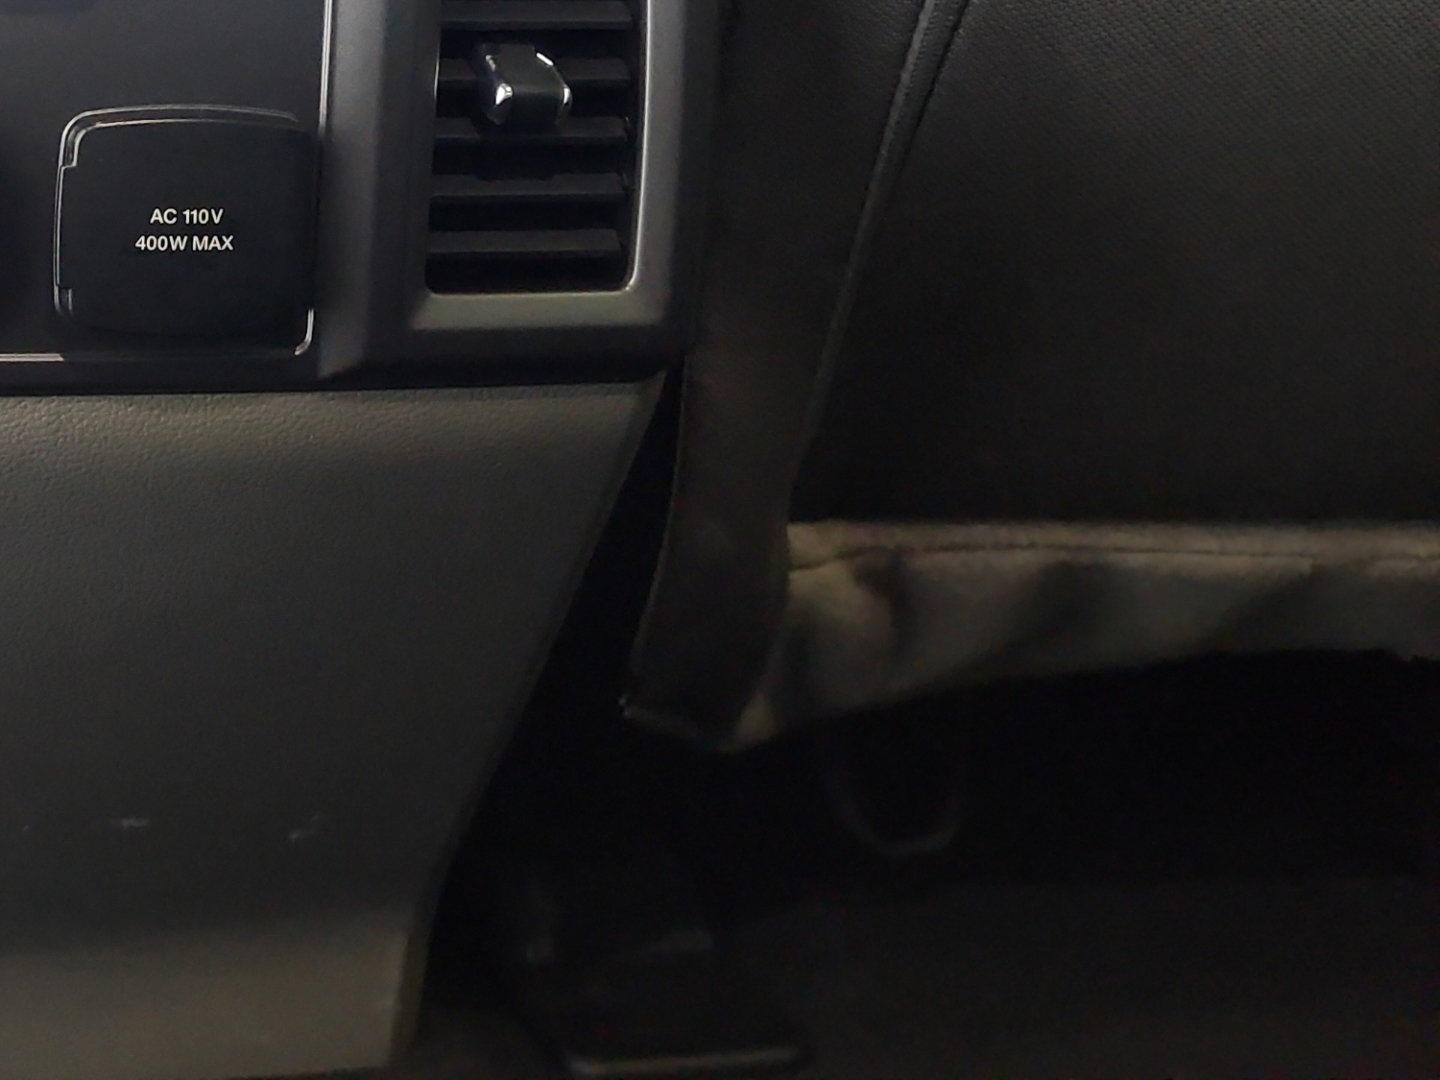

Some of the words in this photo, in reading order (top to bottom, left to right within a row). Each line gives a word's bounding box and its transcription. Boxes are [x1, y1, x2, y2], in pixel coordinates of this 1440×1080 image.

[149, 208, 177, 225] AC
[182, 208, 224, 225] 110V
[135, 235, 188, 251] 400W
[192, 235, 234, 251] MAX
